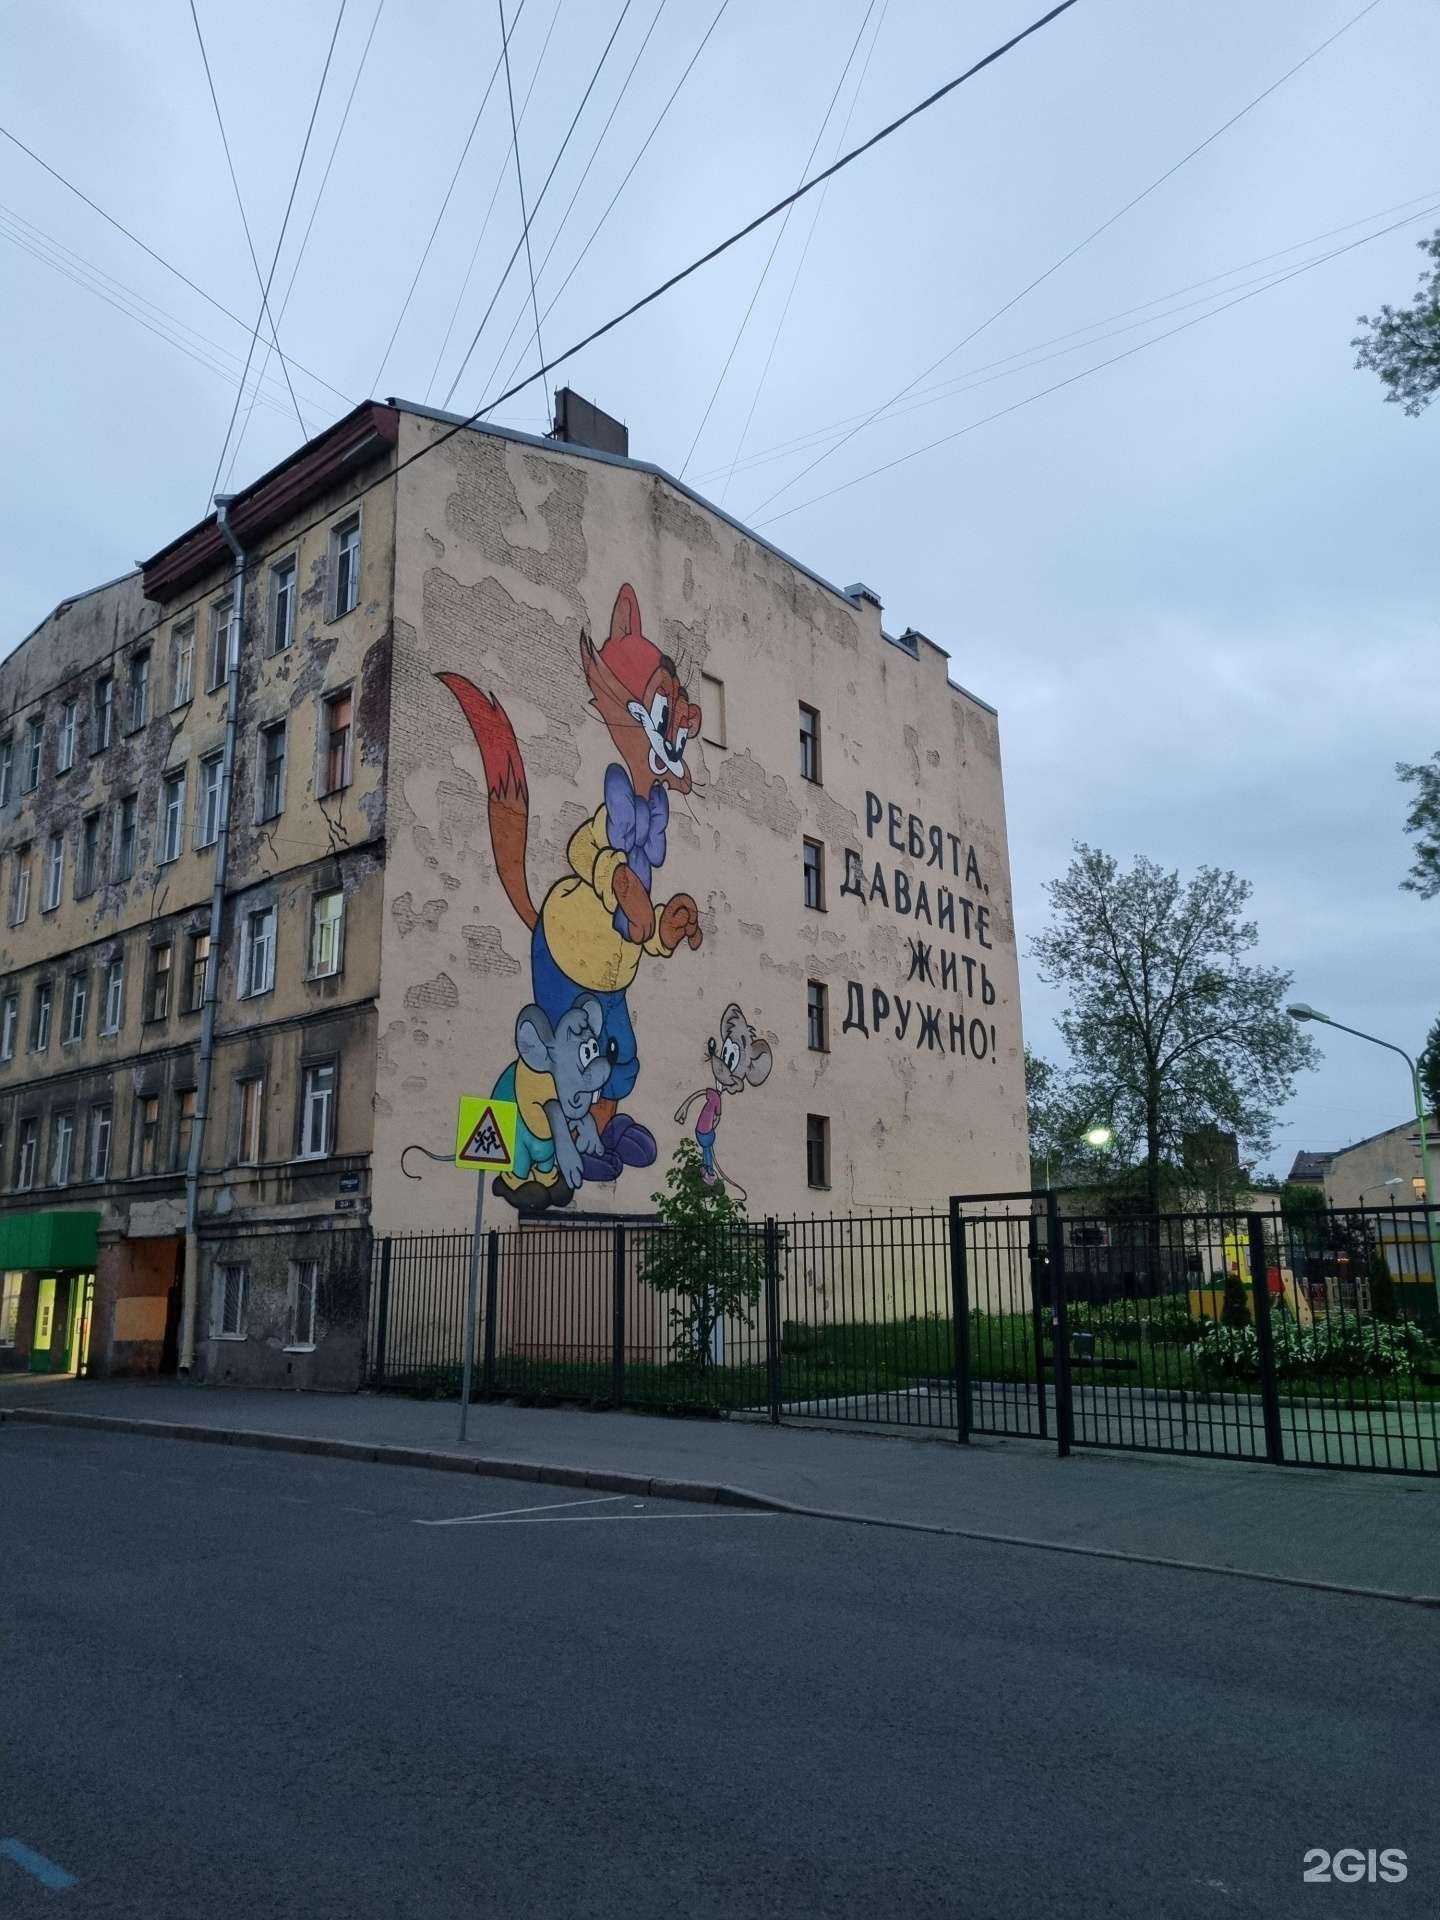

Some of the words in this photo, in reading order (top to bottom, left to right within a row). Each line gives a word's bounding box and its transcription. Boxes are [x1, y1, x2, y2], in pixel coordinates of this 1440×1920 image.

[865, 790, 989, 896] РЕБЯТА,
[840, 847, 992, 950] ДАВАЙТЕ
[907, 937, 995, 1005] ЖИТЬ
[842, 980, 996, 1064] ДРУЖНО!
